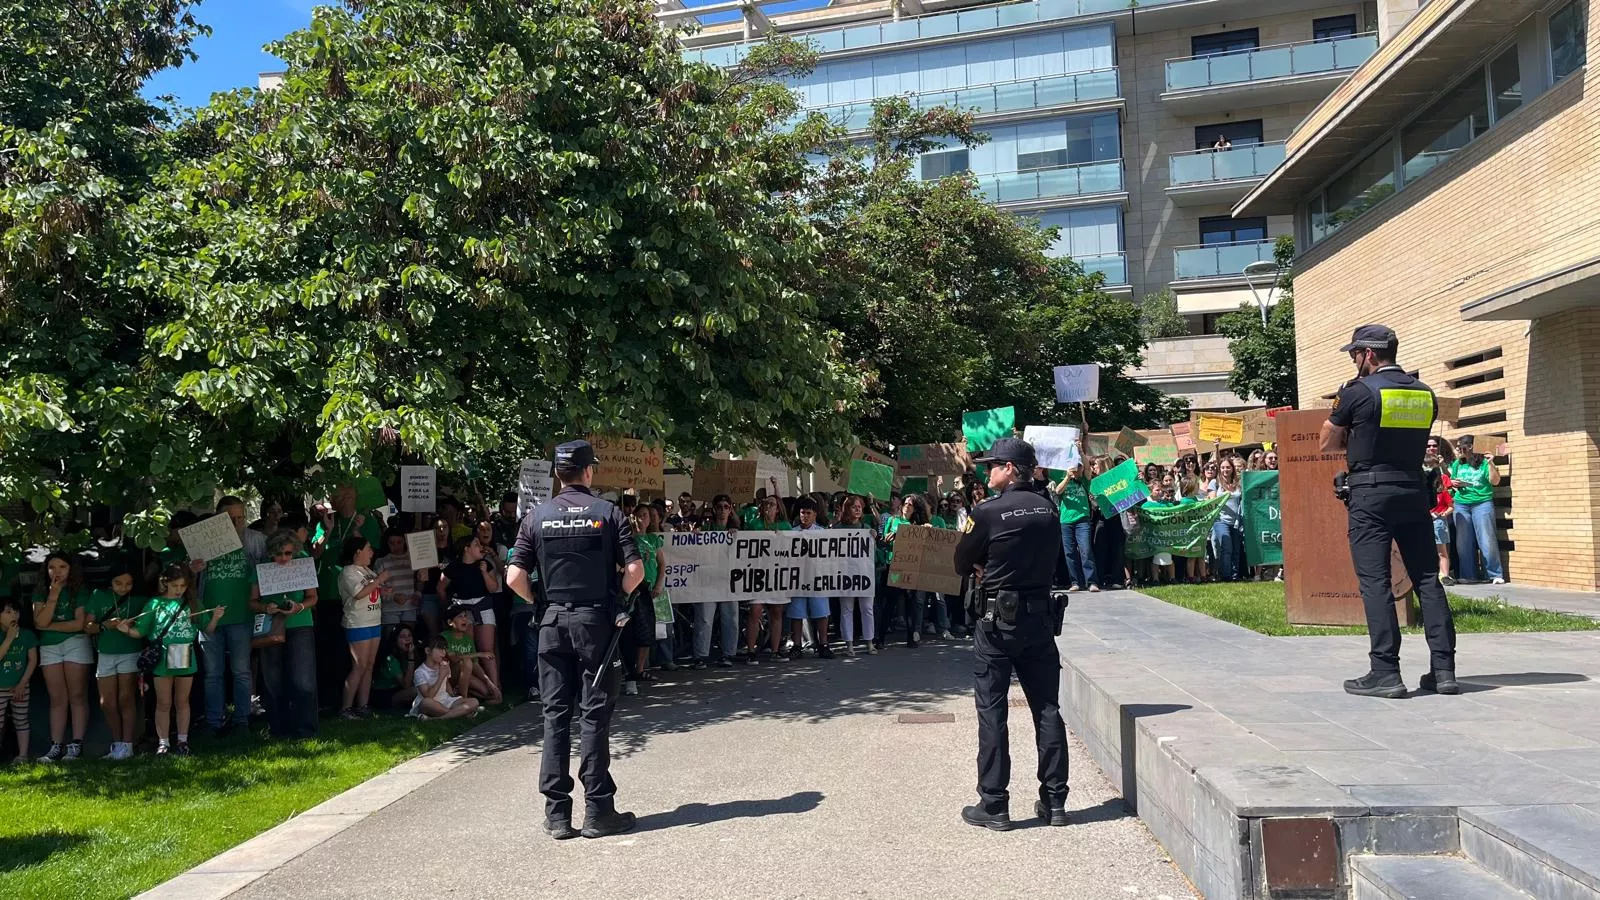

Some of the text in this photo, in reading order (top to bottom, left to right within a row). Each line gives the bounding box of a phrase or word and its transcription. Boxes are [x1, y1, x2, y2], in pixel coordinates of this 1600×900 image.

[1290, 432, 1321, 442] CENTR
[644, 456, 660, 468] NO
[541, 518, 594, 529] POLICIA
[671, 531, 734, 547] MONEGROS
[735, 538, 771, 559] POR
[774, 550, 790, 558] UNA
[790, 531, 870, 558] EDUCACIÓN
[664, 563, 700, 577] aspar
[664, 576, 688, 588] Lax
[729, 563, 872, 593] PÚBLICA DE CALIDAD
